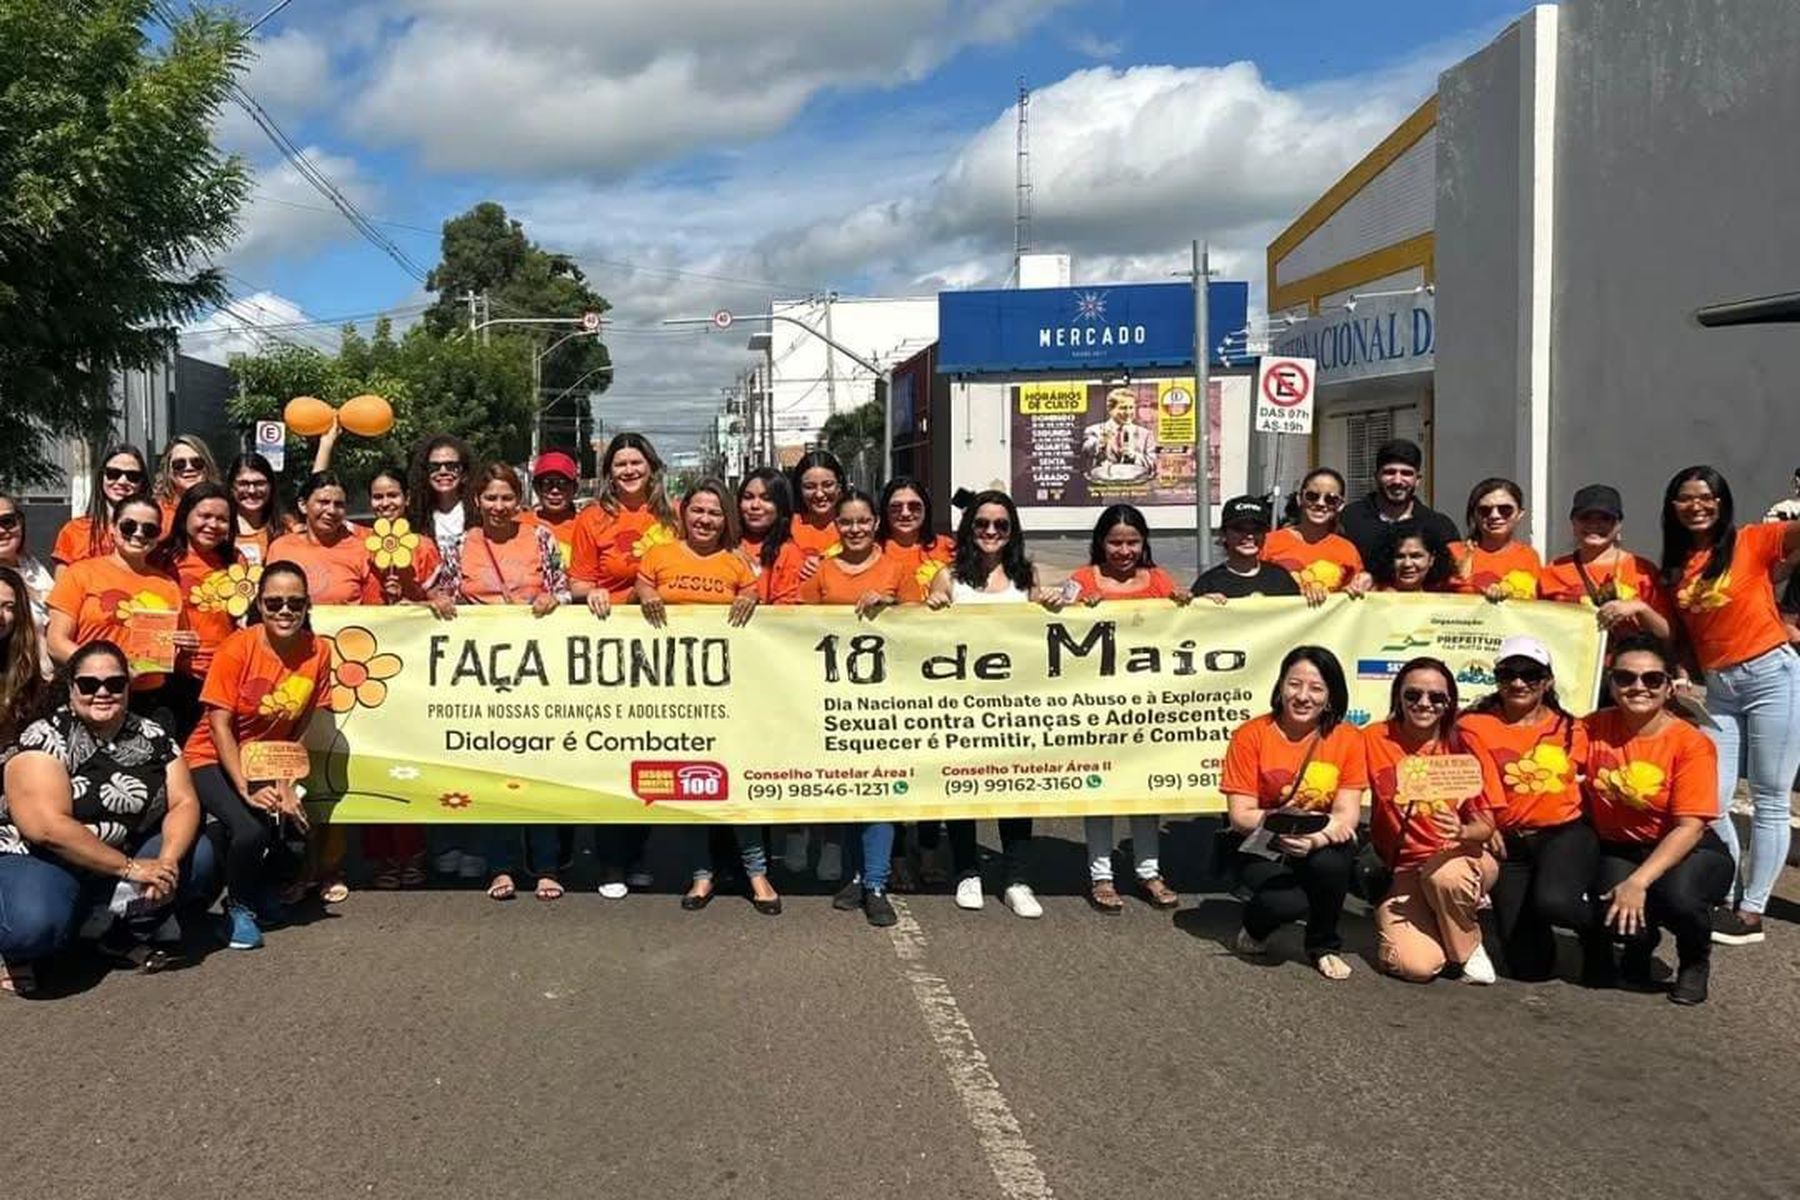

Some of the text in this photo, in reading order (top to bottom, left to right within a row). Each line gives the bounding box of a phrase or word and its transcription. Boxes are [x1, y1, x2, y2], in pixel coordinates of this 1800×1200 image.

[1039, 326, 1146, 347] MERCADO
[1276, 373, 1296, 396] E
[1028, 400, 1079, 410] DE CULTO
[1260, 407, 1309, 420] DAS 07h
[266, 427, 276, 439] E
[1284, 421, 1303, 431] 19h
[1437, 636, 1502, 646] PREFEITUR
[815, 620, 1246, 684] 18 de Maio
[430, 635, 731, 693] FAÇA BONITO
[825, 688, 1252, 711] Dia Nacional de Combate ao Abuso e à Exploração
[428, 704, 731, 722] PROTEJA NOSSAS CRIANÇAS E ADOLESCENTES.
[824, 706, 1251, 732] Sexual contra Crianças e Adolescentes
[446, 730, 717, 754] Dialogar é Combater
[825, 735, 922, 754] Esquecer
[928, 732, 939, 749] é
[945, 732, 1036, 749] Permitir,
[1042, 731, 1129, 746] Lembrar
[1133, 727, 1144, 743] é
[743, 765, 914, 781] Conselho Tutelar Área I
[941, 760, 1112, 777] Conselho Tutelar Área II
[680, 777, 719, 795] 100
[747, 781, 890, 800] (99) 98546-1231
[945, 776, 1083, 796] (99) 99162-3160
[1147, 773, 1224, 790] (99) 981
